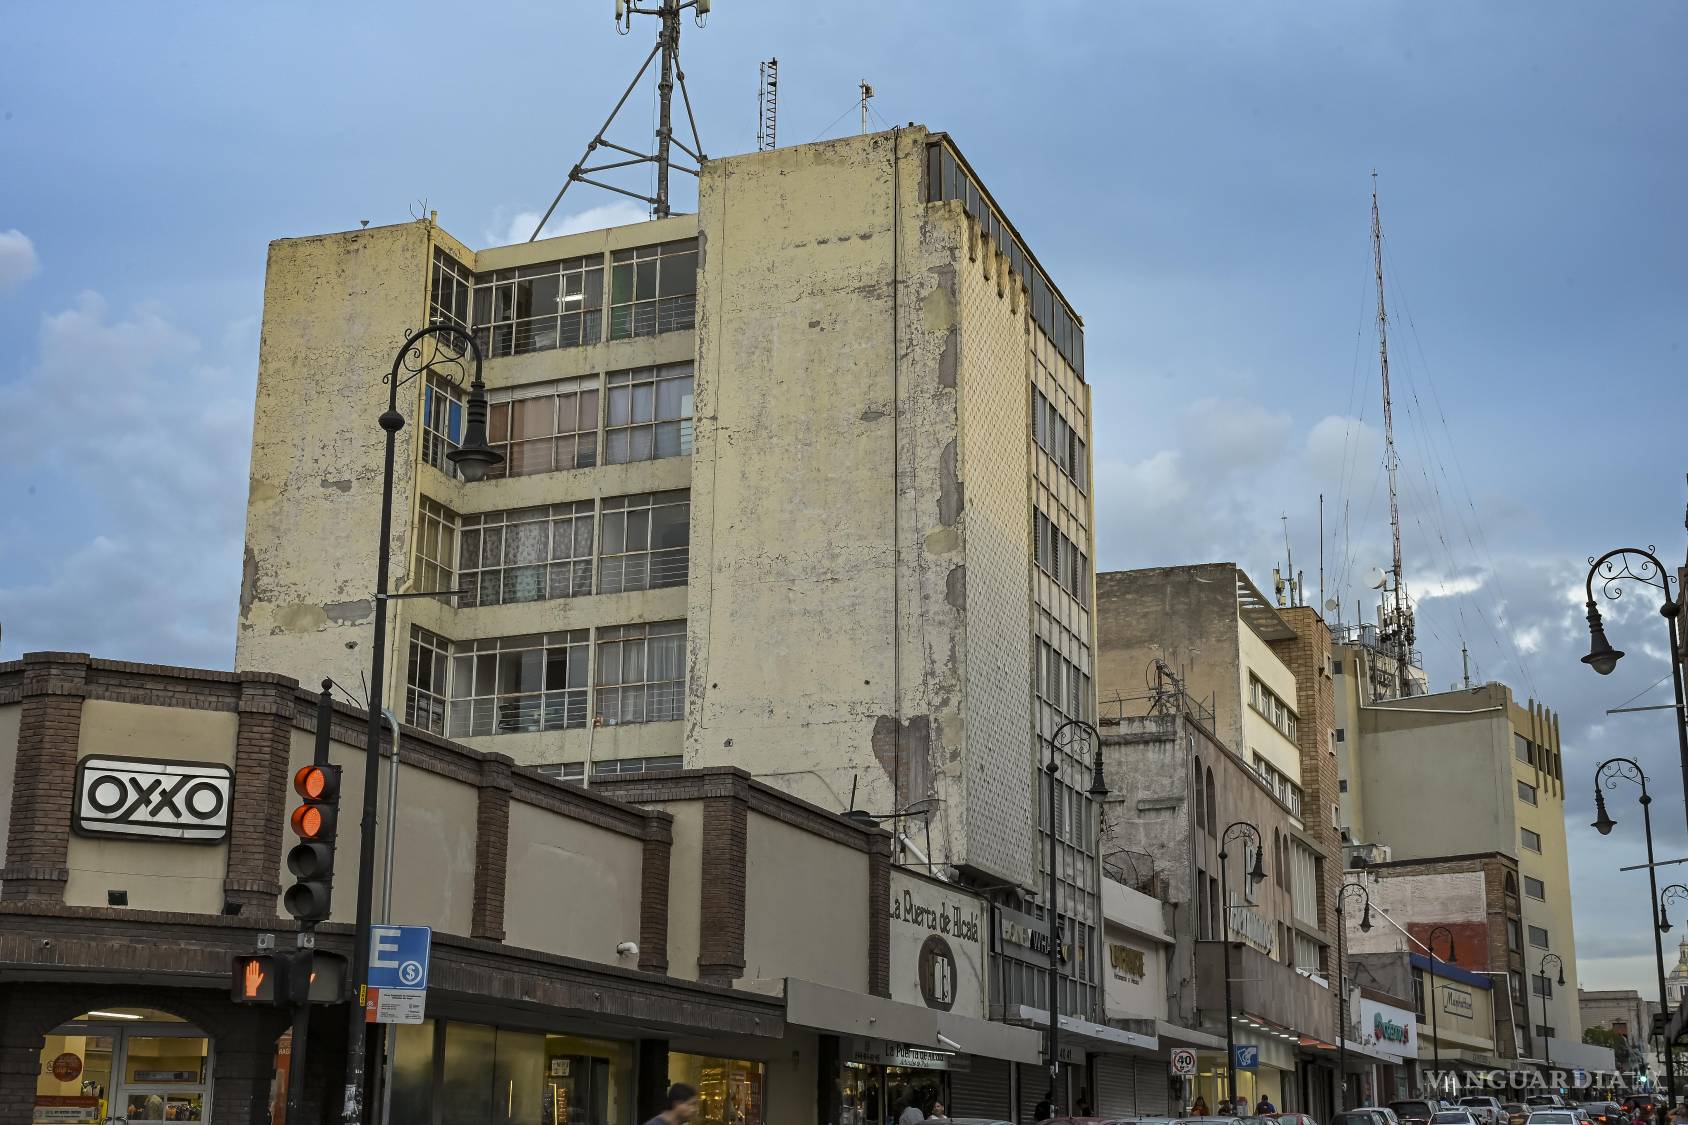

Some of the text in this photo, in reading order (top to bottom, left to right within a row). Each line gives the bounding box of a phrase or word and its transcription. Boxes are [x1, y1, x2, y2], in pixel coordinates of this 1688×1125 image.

[87, 773, 224, 822] OXXO
[890, 889, 979, 943] a Puerta de Alcalá
[369, 928, 402, 969] E
[1177, 1055, 1192, 1065] 40
